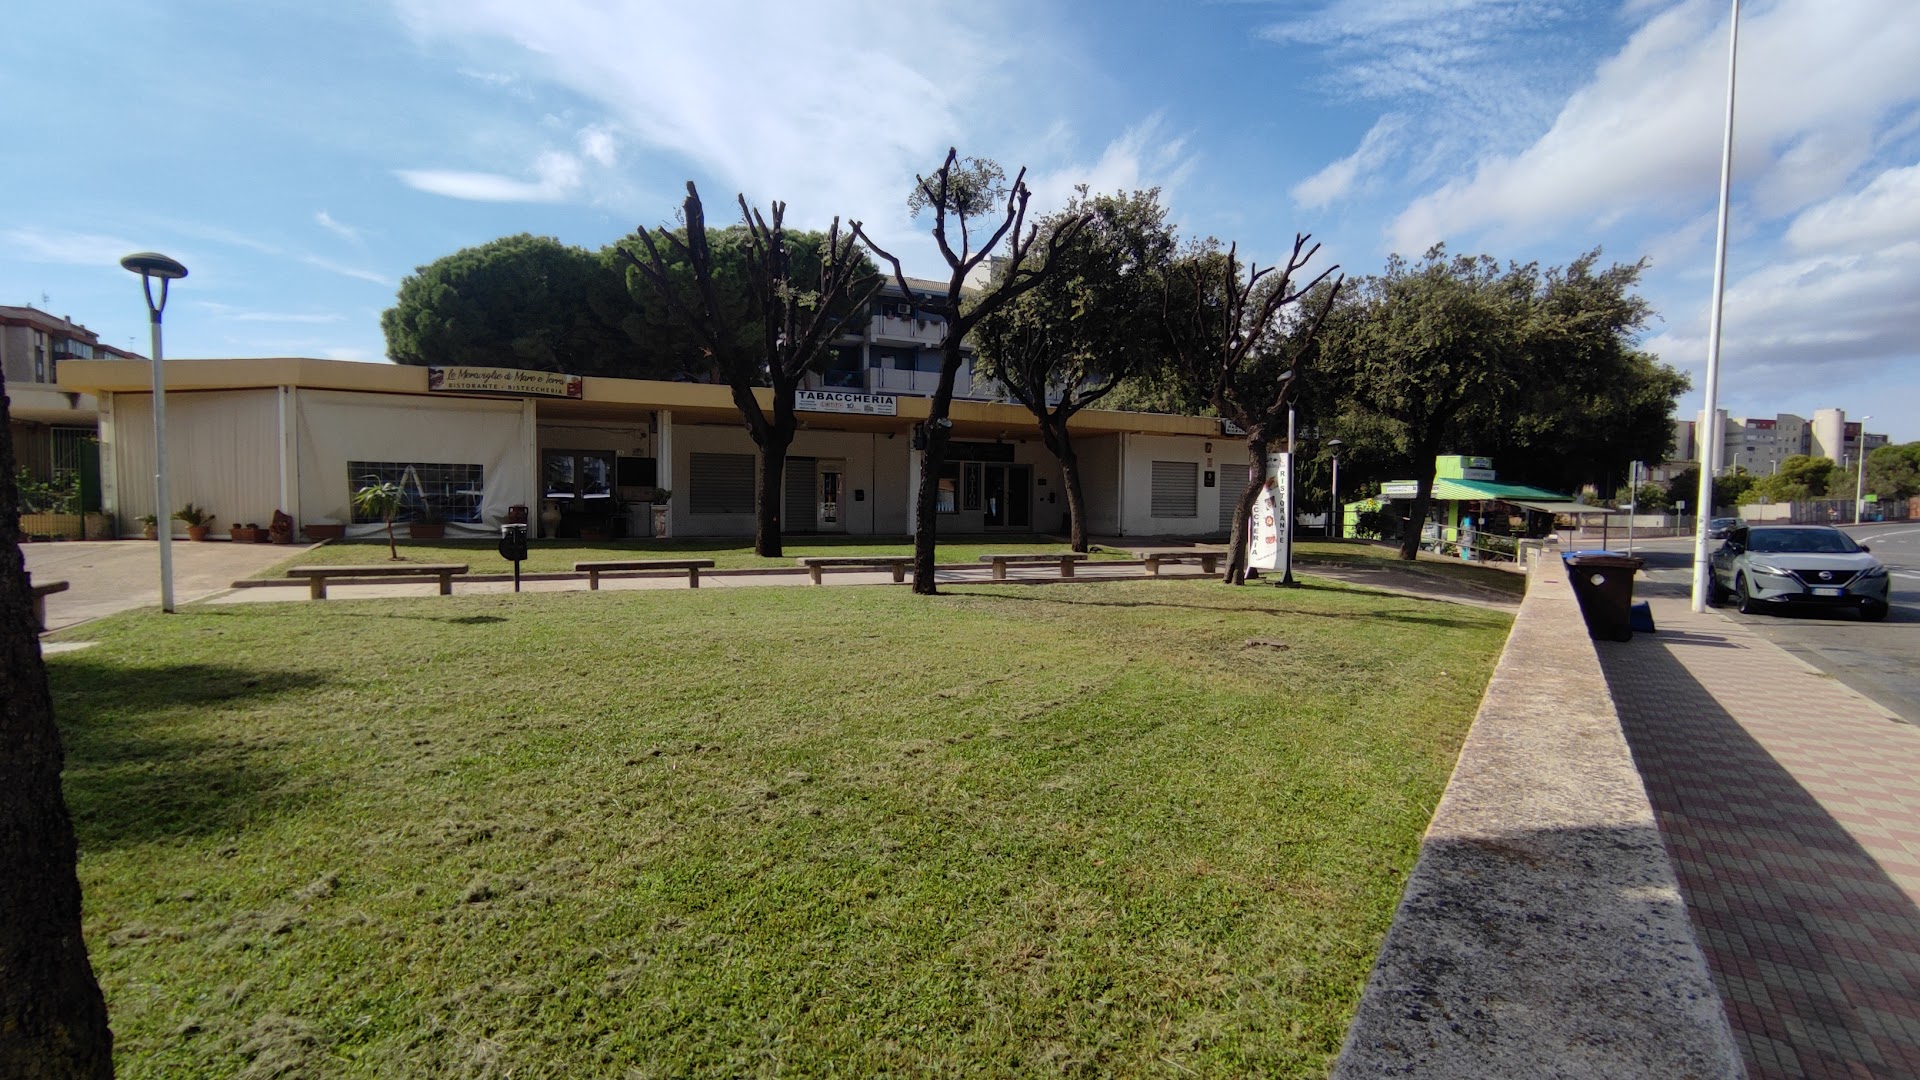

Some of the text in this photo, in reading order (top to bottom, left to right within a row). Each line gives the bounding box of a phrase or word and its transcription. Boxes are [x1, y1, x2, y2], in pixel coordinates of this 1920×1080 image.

[458, 368, 502, 382] Meraviglie
[504, 371, 512, 380] di
[514, 372, 536, 382] Mare
[546, 373, 566, 386] Terra
[508, 385, 563, 394] BISTECCHERIA
[798, 392, 893, 404] TABACCHERIA
